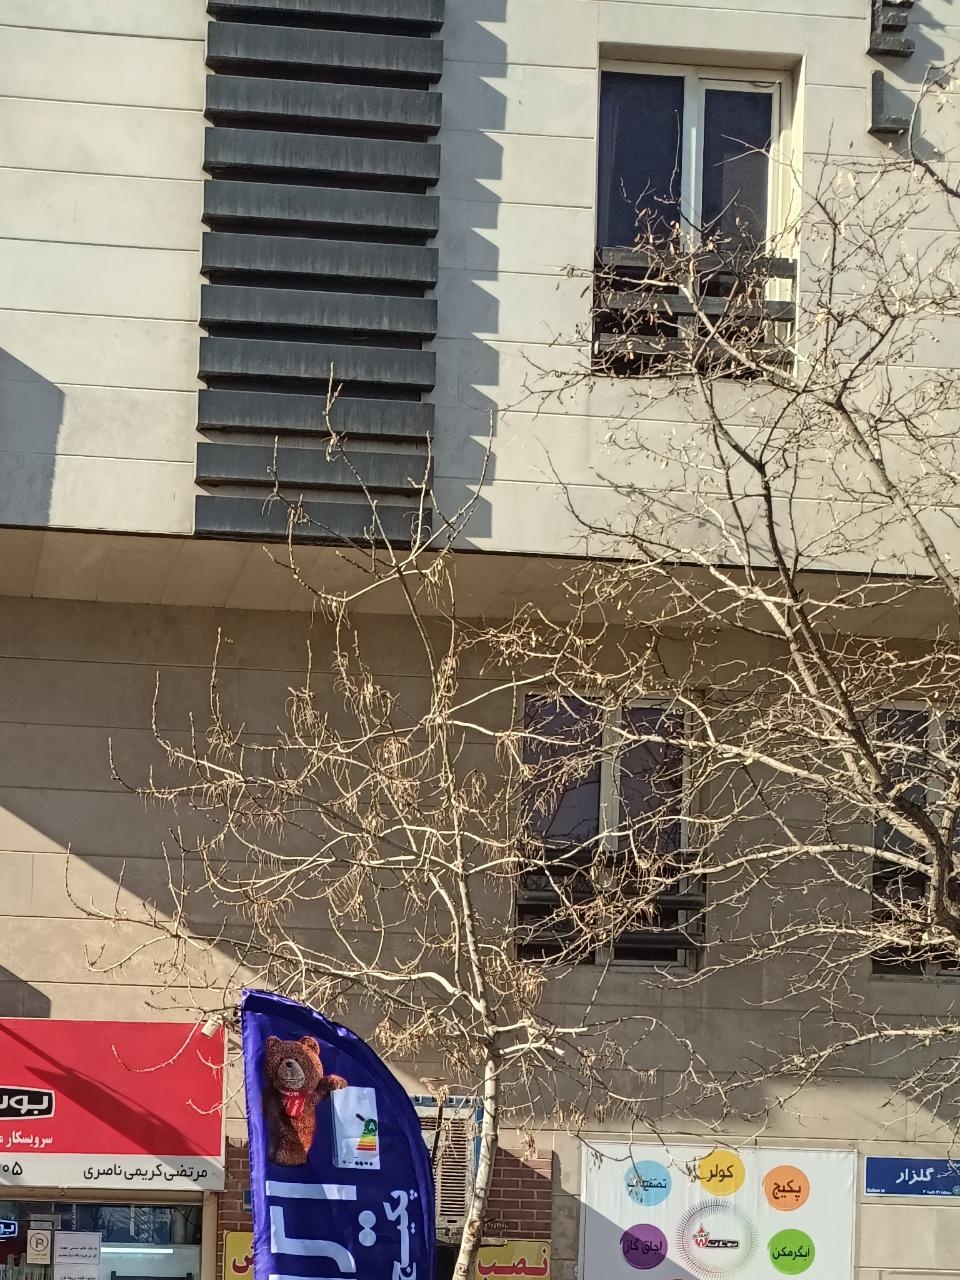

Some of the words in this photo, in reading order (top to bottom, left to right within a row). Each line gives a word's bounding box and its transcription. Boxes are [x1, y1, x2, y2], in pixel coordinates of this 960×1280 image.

[6, 1129, 53, 1149] سرویسکار
[83, 1163, 123, 1180] ناصری
[124, 1163, 163, 1181] کریمی
[164, 1164, 208, 1182] مرتضی
[706, 1163, 734, 1182] کولر
[895, 1167, 935, 1185] گلزار
[772, 1179, 802, 1201] پکیج
[624, 1238, 641, 1254] گاز
[641, 1240, 663, 1255] اجاق
